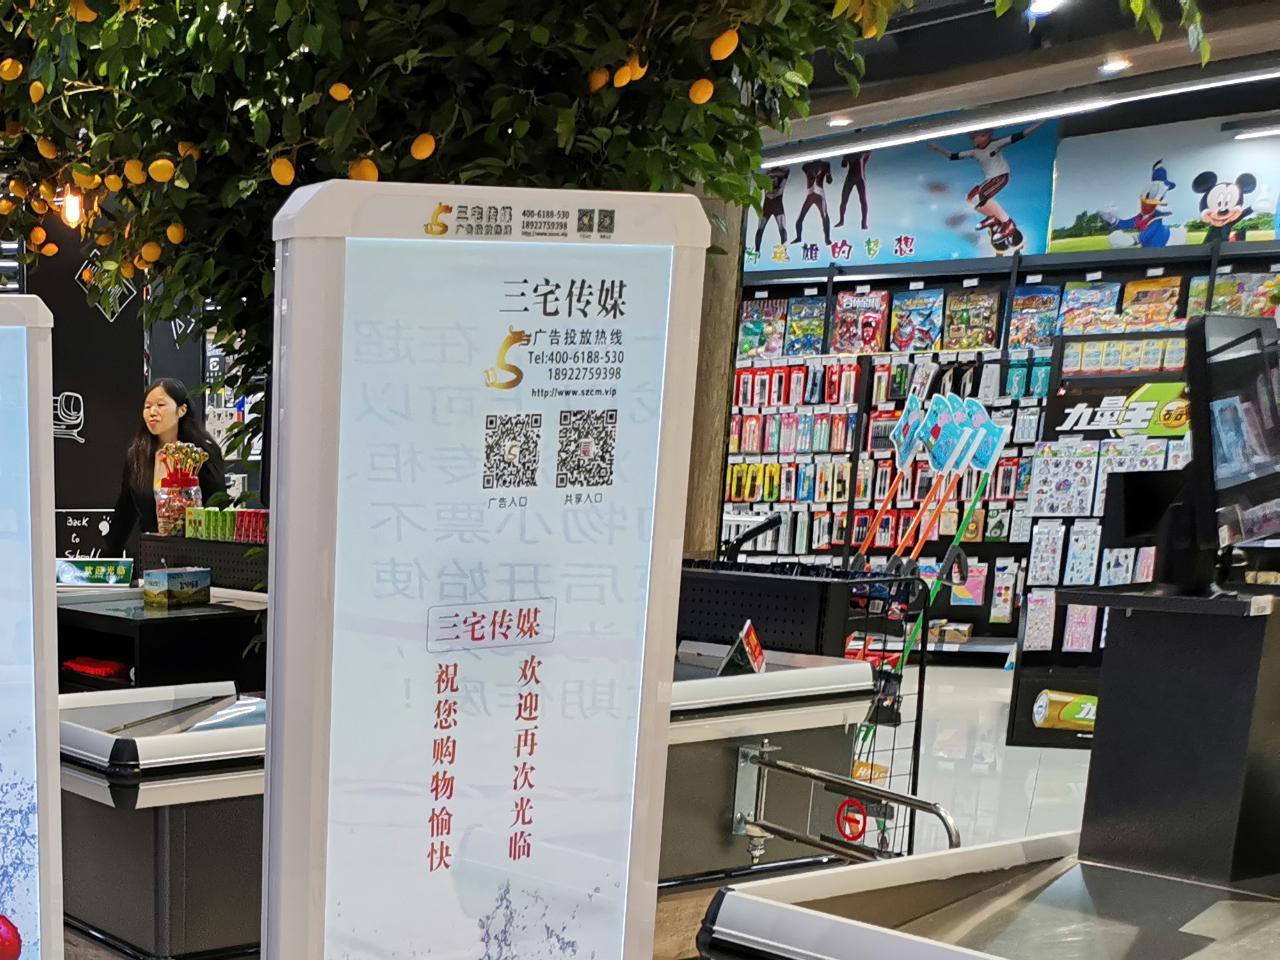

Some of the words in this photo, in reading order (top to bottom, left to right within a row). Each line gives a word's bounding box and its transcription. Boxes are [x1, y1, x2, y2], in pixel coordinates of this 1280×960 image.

[499, 278, 628, 319] 三宅传媒
[531, 328, 624, 346] 广告投放热线
[528, 350, 625, 366] Tel:400-6188-530
[548, 367, 622, 381] 18922759398
[531, 387, 617, 400] http://www.szcm.vip
[487, 496, 528, 509] 广告入口
[564, 493, 603, 506] 共享入口
[435, 606, 542, 643] 三宅传媒
[508, 655, 544, 861] 欢迎再次光临
[427, 662, 460, 873] 祝您购物愉快
